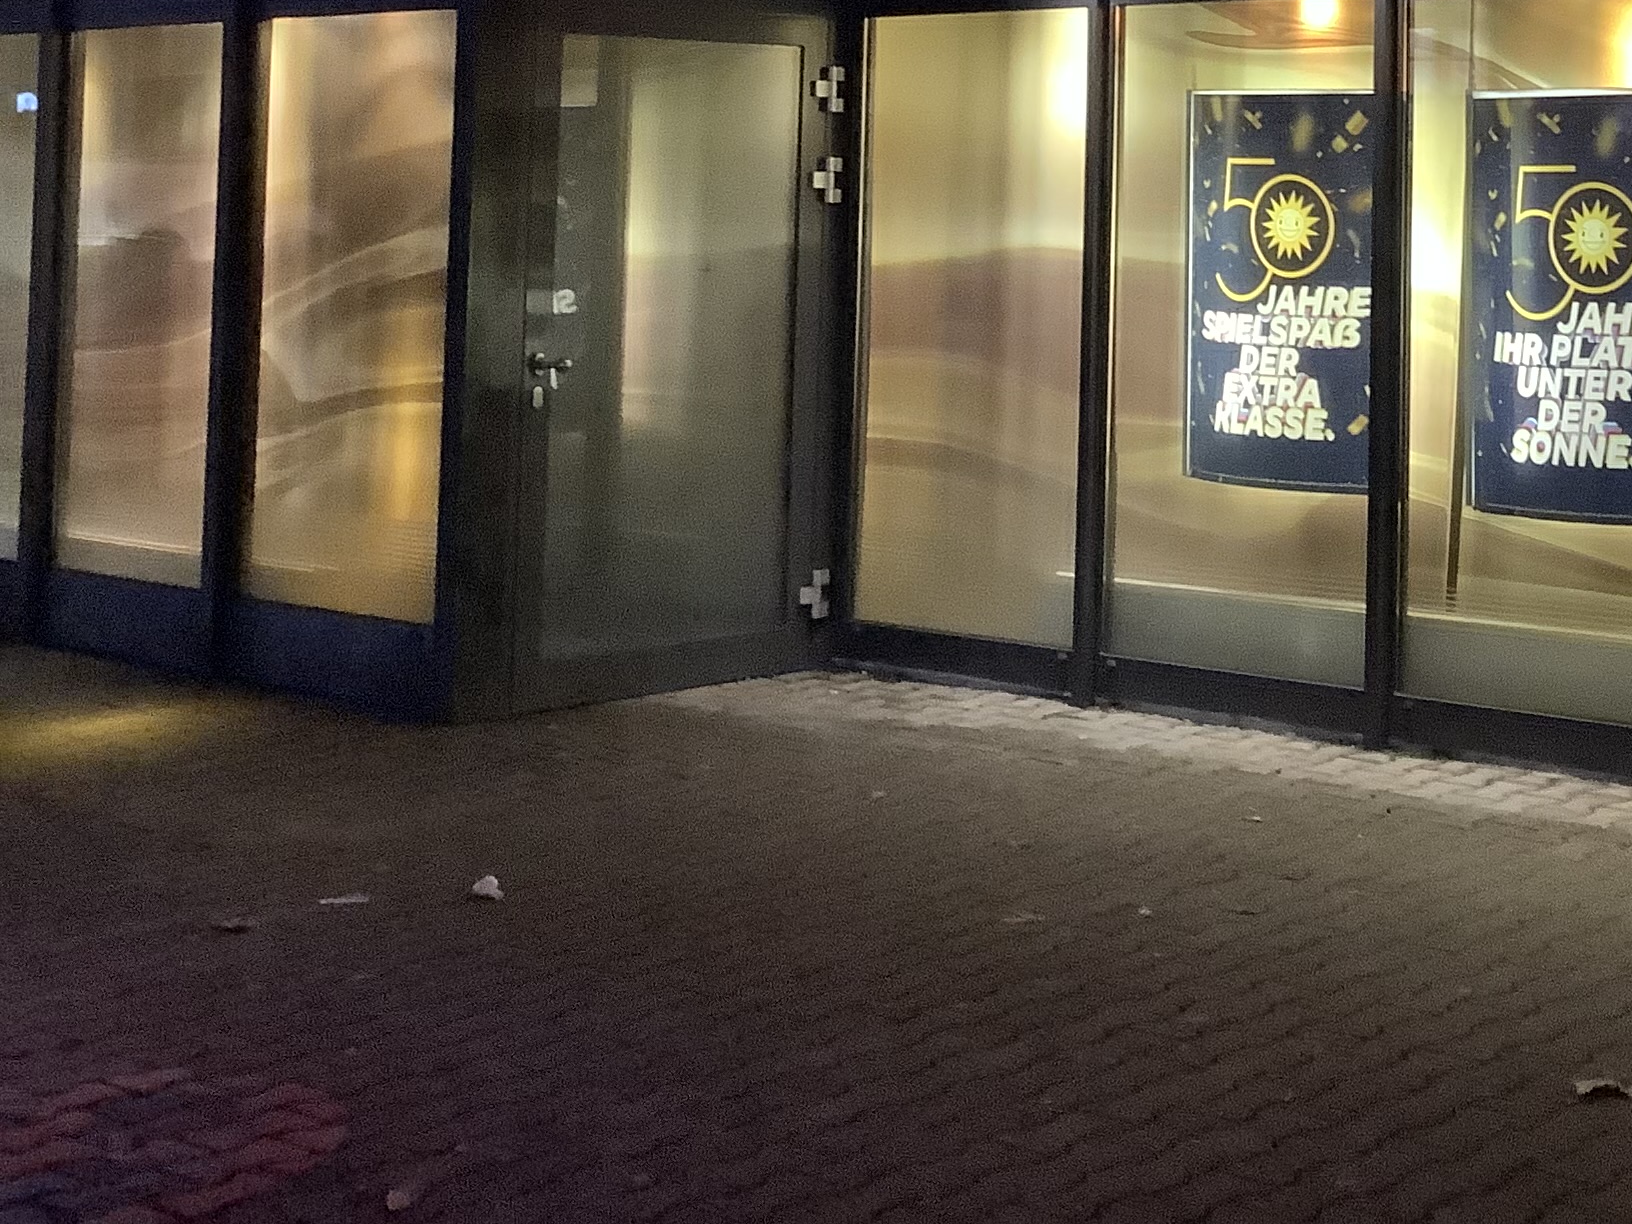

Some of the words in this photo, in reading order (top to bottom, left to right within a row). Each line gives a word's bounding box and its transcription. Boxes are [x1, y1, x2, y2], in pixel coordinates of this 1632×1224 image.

[1215, 157, 1336, 303] 50
[1257, 284, 1372, 318] JAHRE
[1238, 344, 1300, 377] DER
[1493, 331, 1546, 367] IHR
[1222, 371, 1322, 409] EXTRA
[1213, 400, 1336, 443] KLASSE.
[1536, 398, 1607, 434] DER
